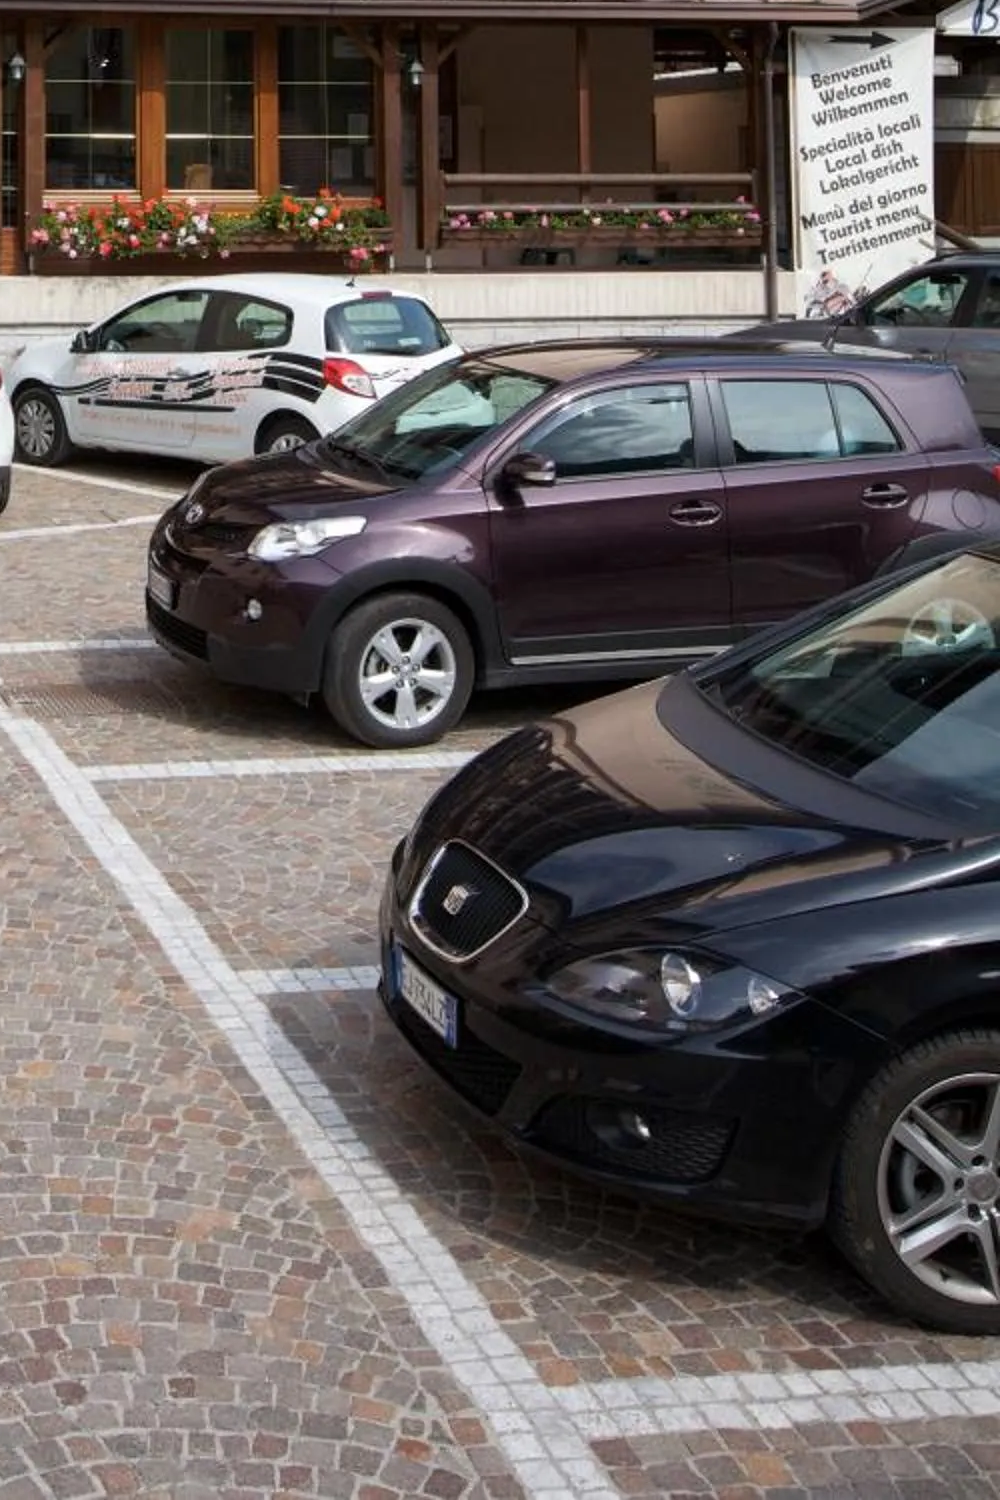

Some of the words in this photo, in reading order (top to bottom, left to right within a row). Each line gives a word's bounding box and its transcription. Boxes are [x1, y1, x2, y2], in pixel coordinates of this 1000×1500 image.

[811, 54, 893, 89] Benvenuti
[819, 77, 893, 105] Welcome
[799, 127, 875, 162] Specialità
[877, 113, 922, 139] locali
[824, 148, 868, 174] Local
[871, 139, 904, 161] dish
[819, 154, 920, 195] Lokalgericht
[800, 204, 845, 230] Menù
[848, 195, 874, 215] del
[877, 183, 928, 208] giorno
[820, 217, 873, 244] Tourist
[876, 205, 920, 227] menu
